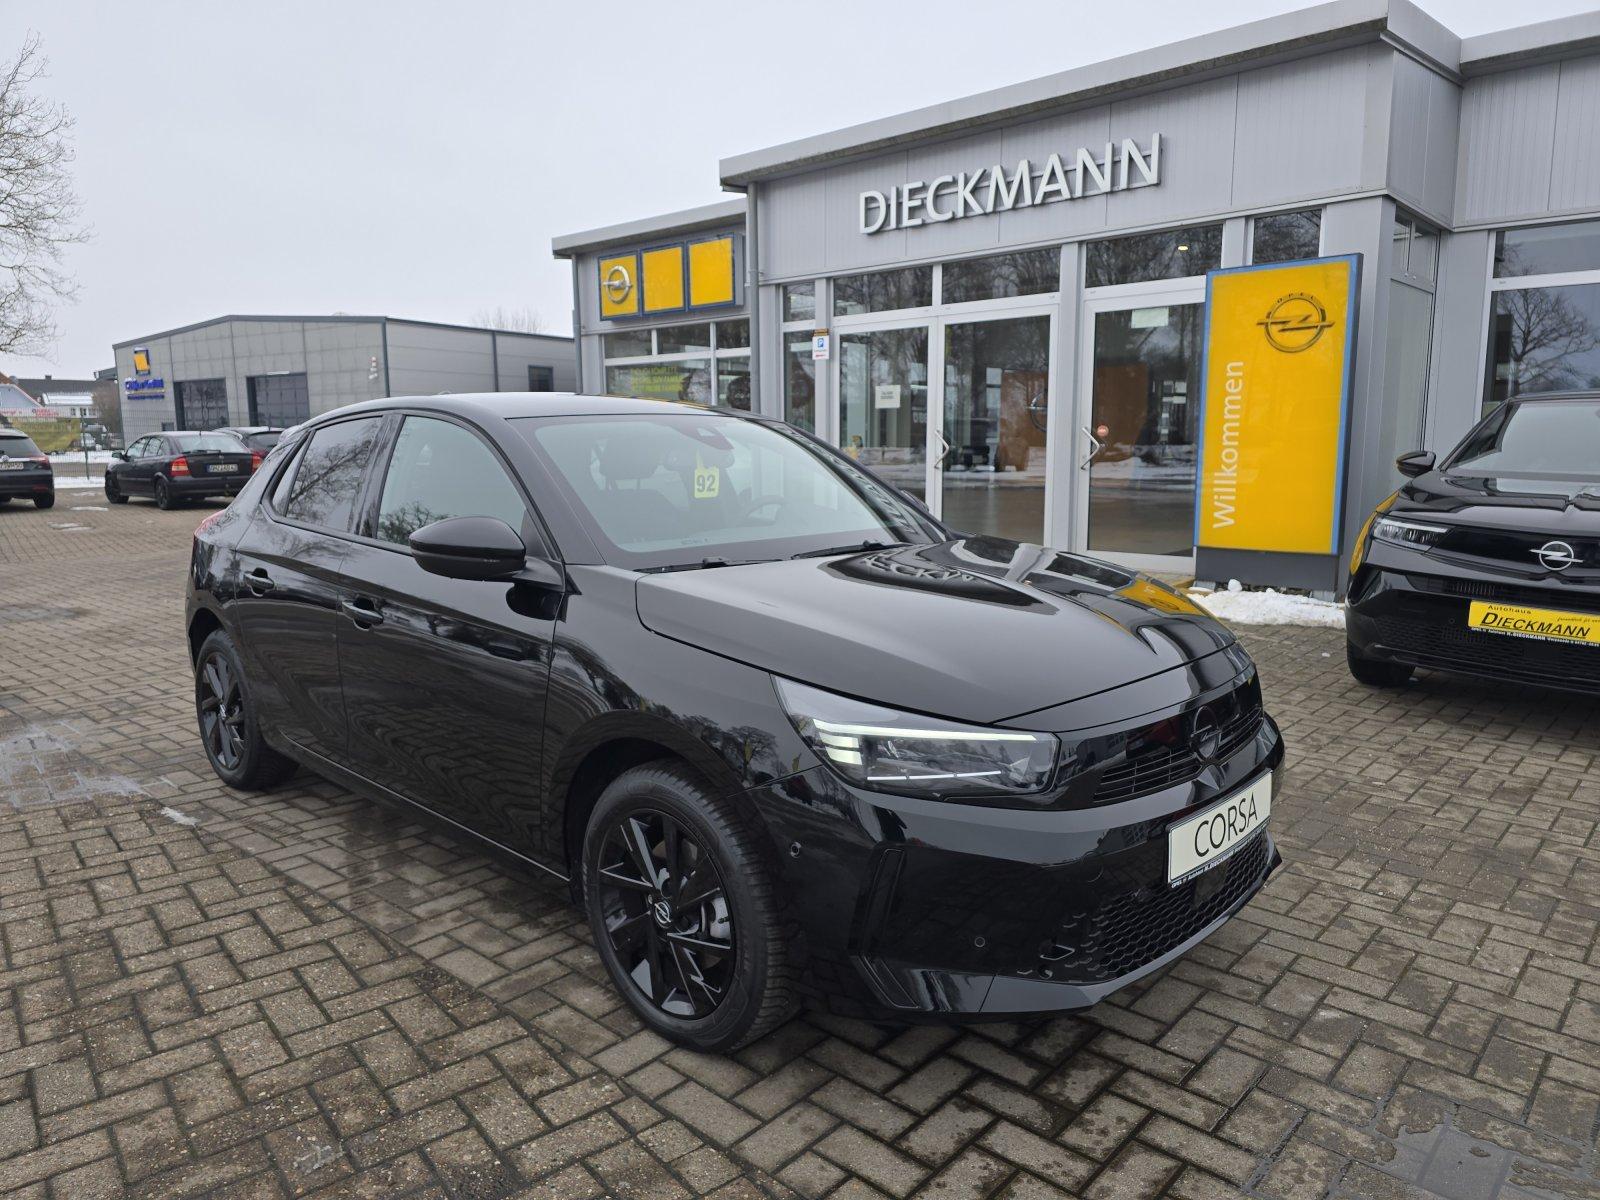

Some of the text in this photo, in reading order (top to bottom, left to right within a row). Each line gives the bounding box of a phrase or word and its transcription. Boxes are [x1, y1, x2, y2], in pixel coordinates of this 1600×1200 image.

[859, 132, 1163, 235] DIECKMANN
[1212, 360, 1244, 529] Willkommen
[696, 474, 716, 493] 92
[1481, 612, 1591, 637] DIECKMANN
[1488, 604, 1532, 615] Autohaus
[1194, 791, 1258, 858] CORSA
